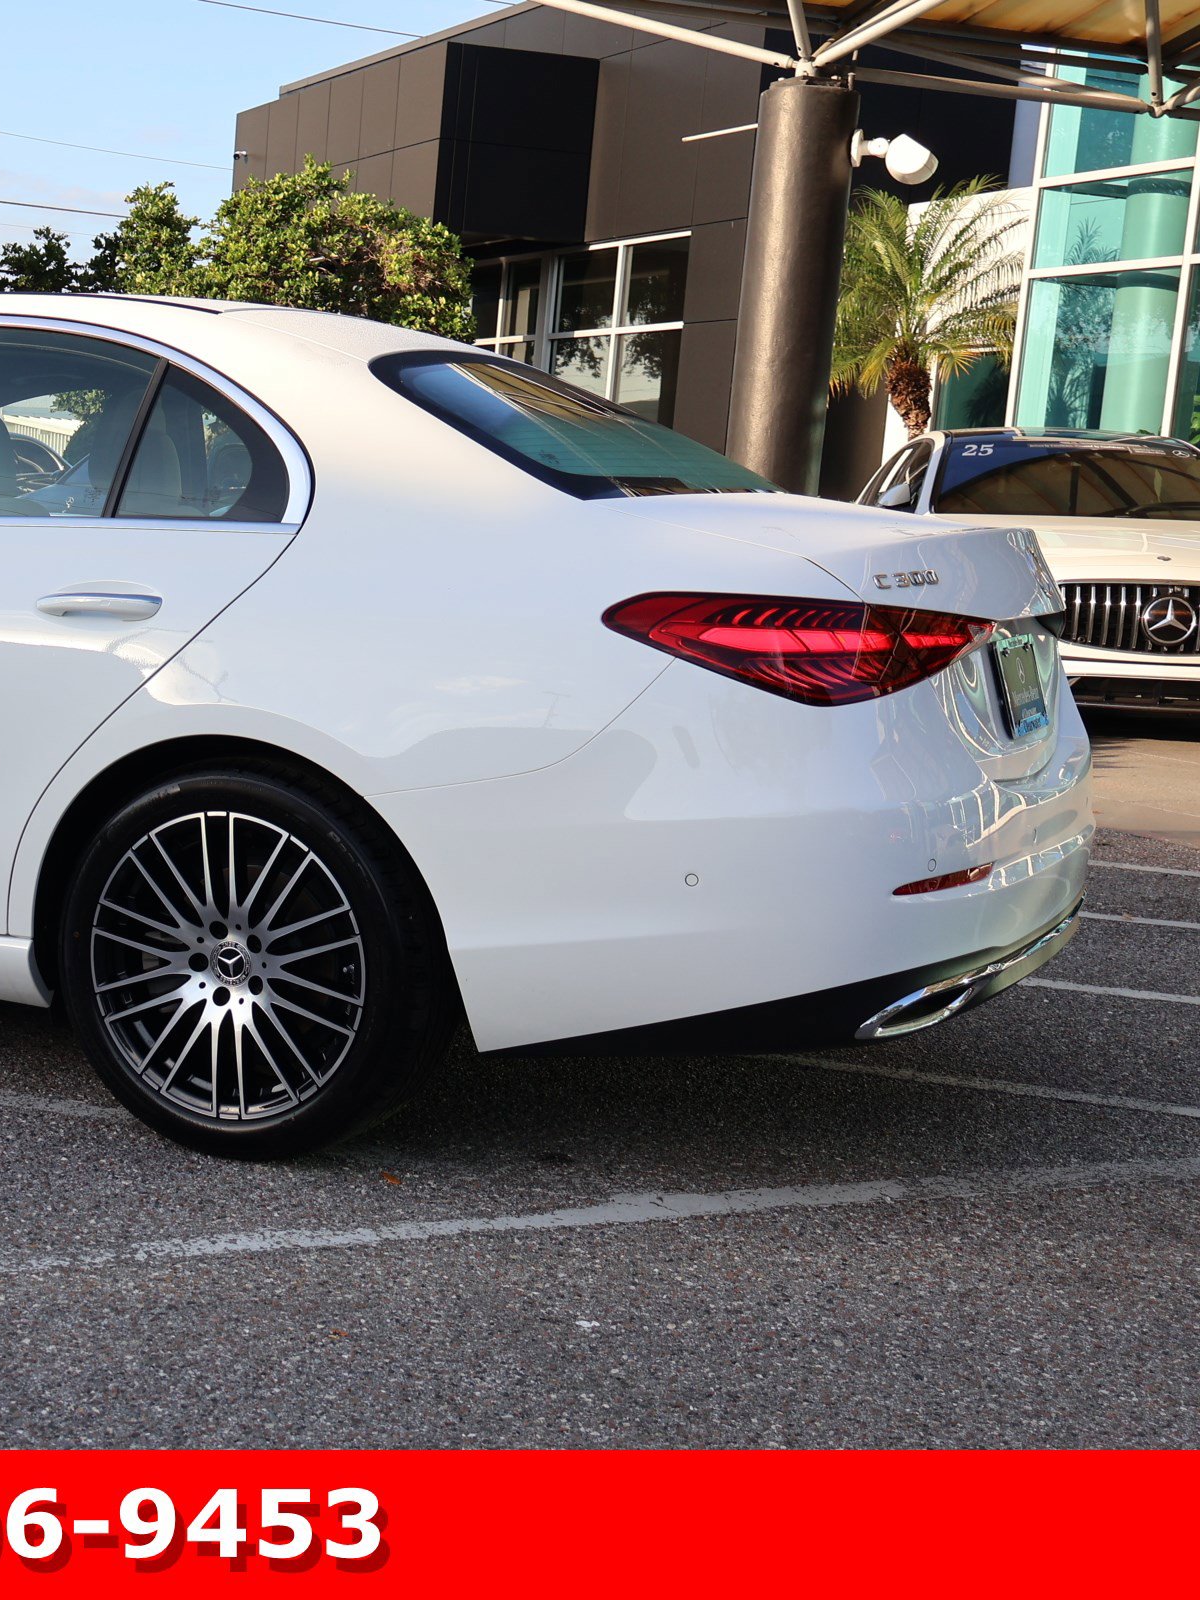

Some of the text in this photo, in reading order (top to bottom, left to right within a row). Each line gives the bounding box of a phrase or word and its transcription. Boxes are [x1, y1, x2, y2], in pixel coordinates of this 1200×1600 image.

[961, 444, 994, 457] 25
[873, 569, 939, 589] C 300
